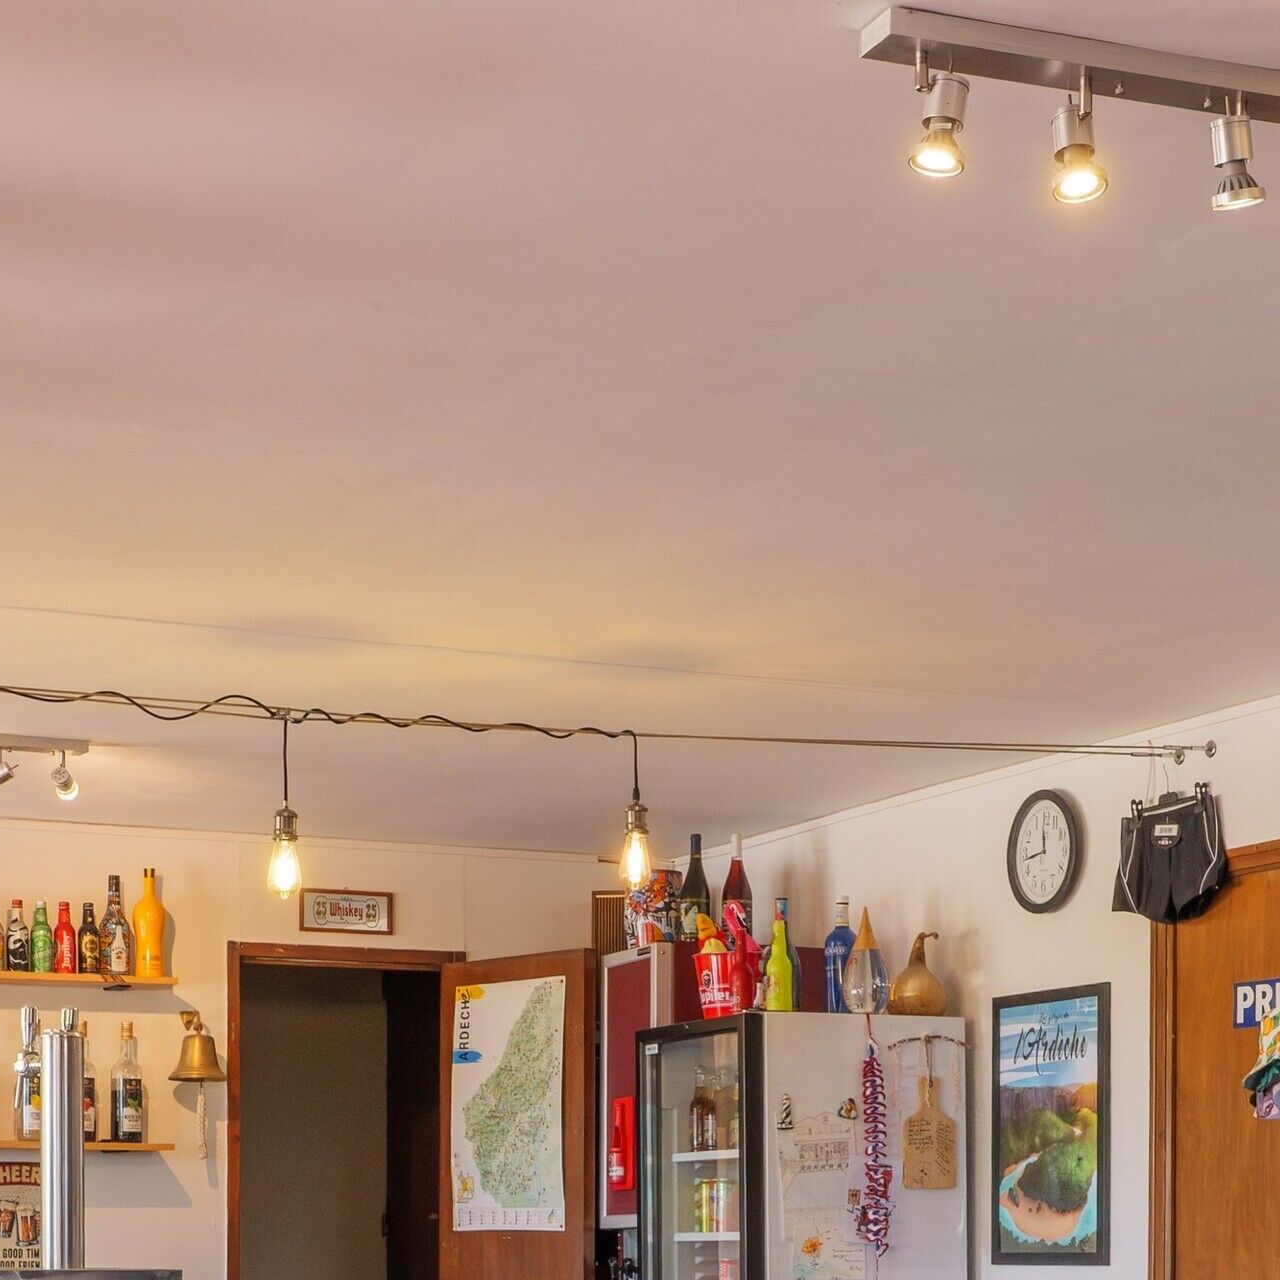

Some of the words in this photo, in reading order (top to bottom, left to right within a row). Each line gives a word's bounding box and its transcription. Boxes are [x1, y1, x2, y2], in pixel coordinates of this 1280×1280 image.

[315, 901, 327, 916] 25
[329, 902, 364, 920] Whiskey
[365, 904, 377, 919] 25
[61, 934, 72, 971] Jupiler
[3, 1248, 24, 1259] GOOD
[26, 1248, 40, 1259] TIM
